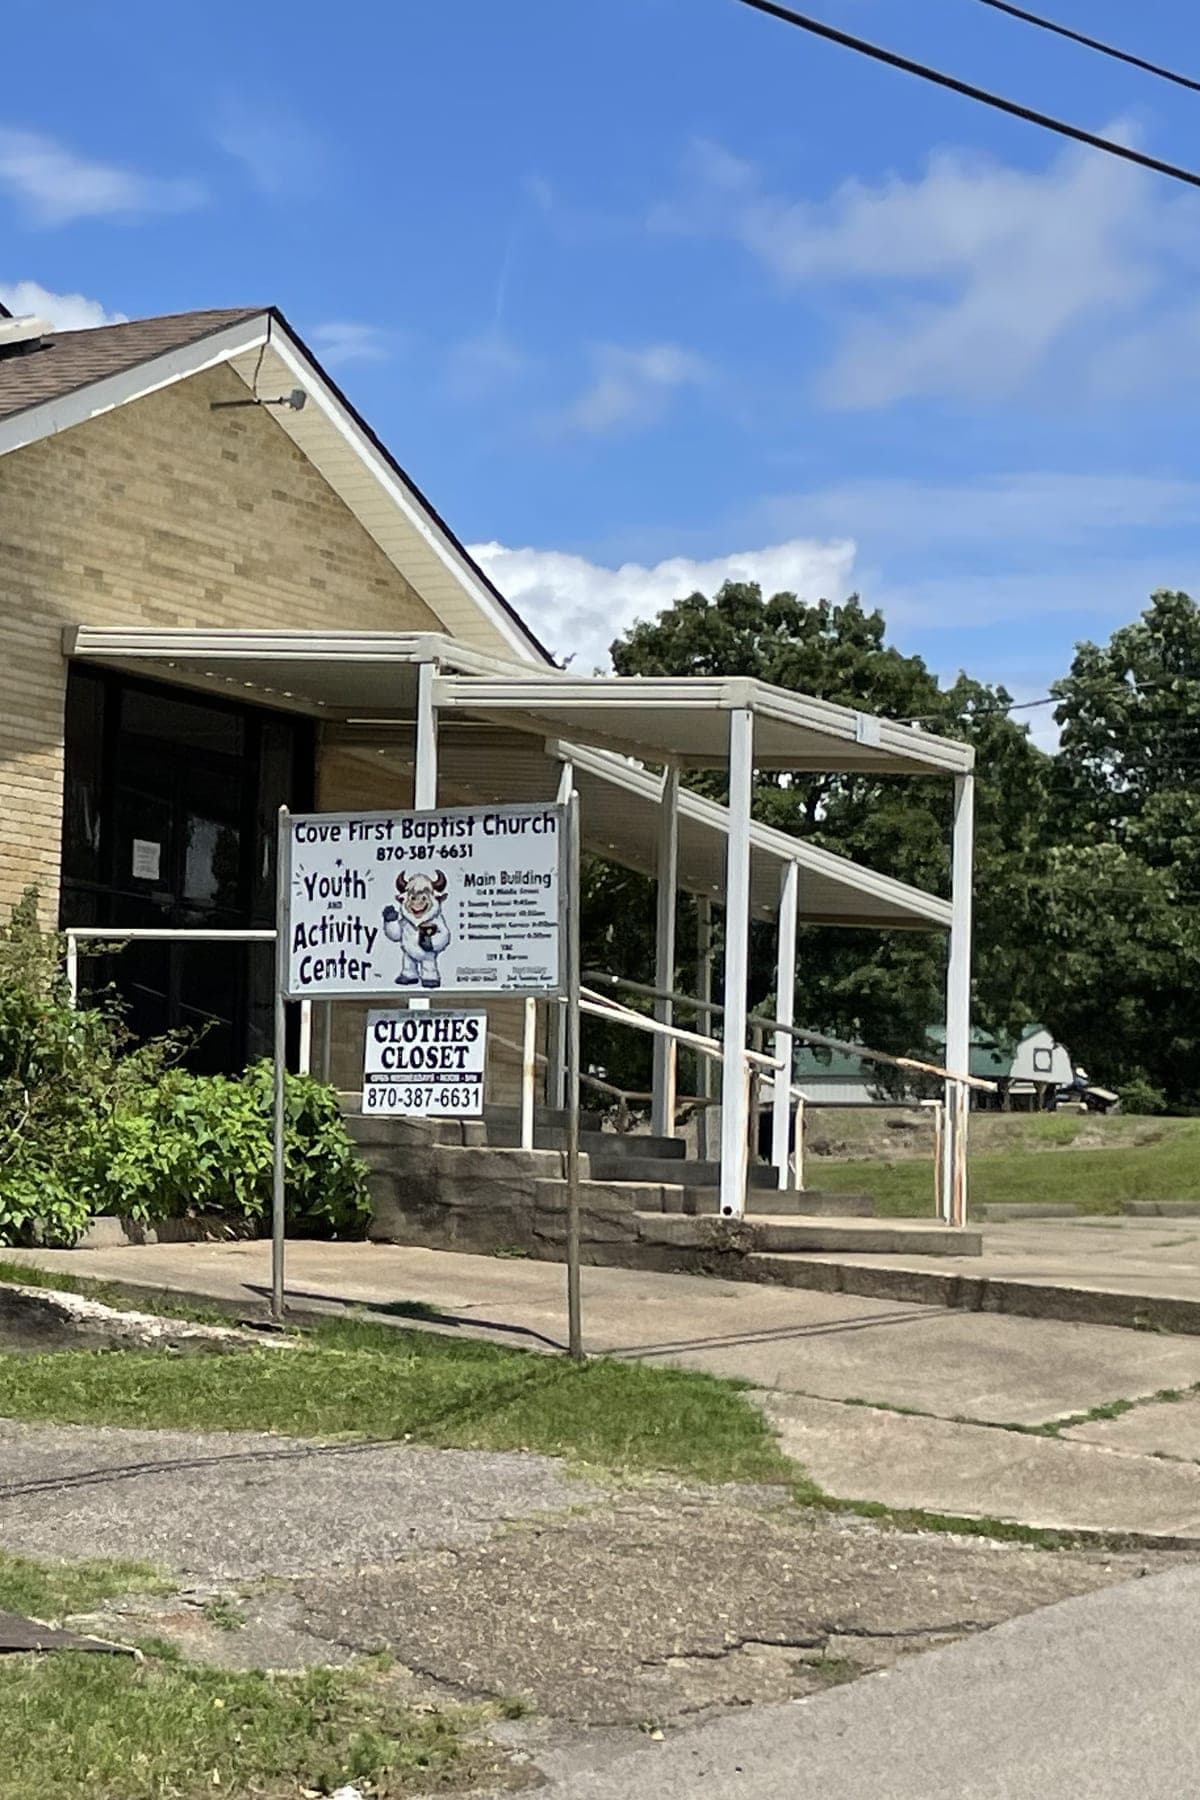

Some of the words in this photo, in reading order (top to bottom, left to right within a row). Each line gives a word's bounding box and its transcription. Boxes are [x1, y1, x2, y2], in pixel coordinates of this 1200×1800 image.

[295, 822, 341, 844] Cove
[349, 819, 394, 842] First
[402, 815, 475, 844] Baptist
[483, 812, 555, 835] Church
[376, 843, 474, 861] 870-387-6631
[304, 869, 366, 900] Youth
[464, 872, 496, 888] Main
[500, 870, 552, 888] Building
[293, 913, 378, 954] Activity
[300, 950, 372, 985] Center
[374, 1019, 479, 1043] CLOTHES
[381, 1045, 469, 1069] CLOSET
[368, 1088, 480, 1108] 870-387-6631
